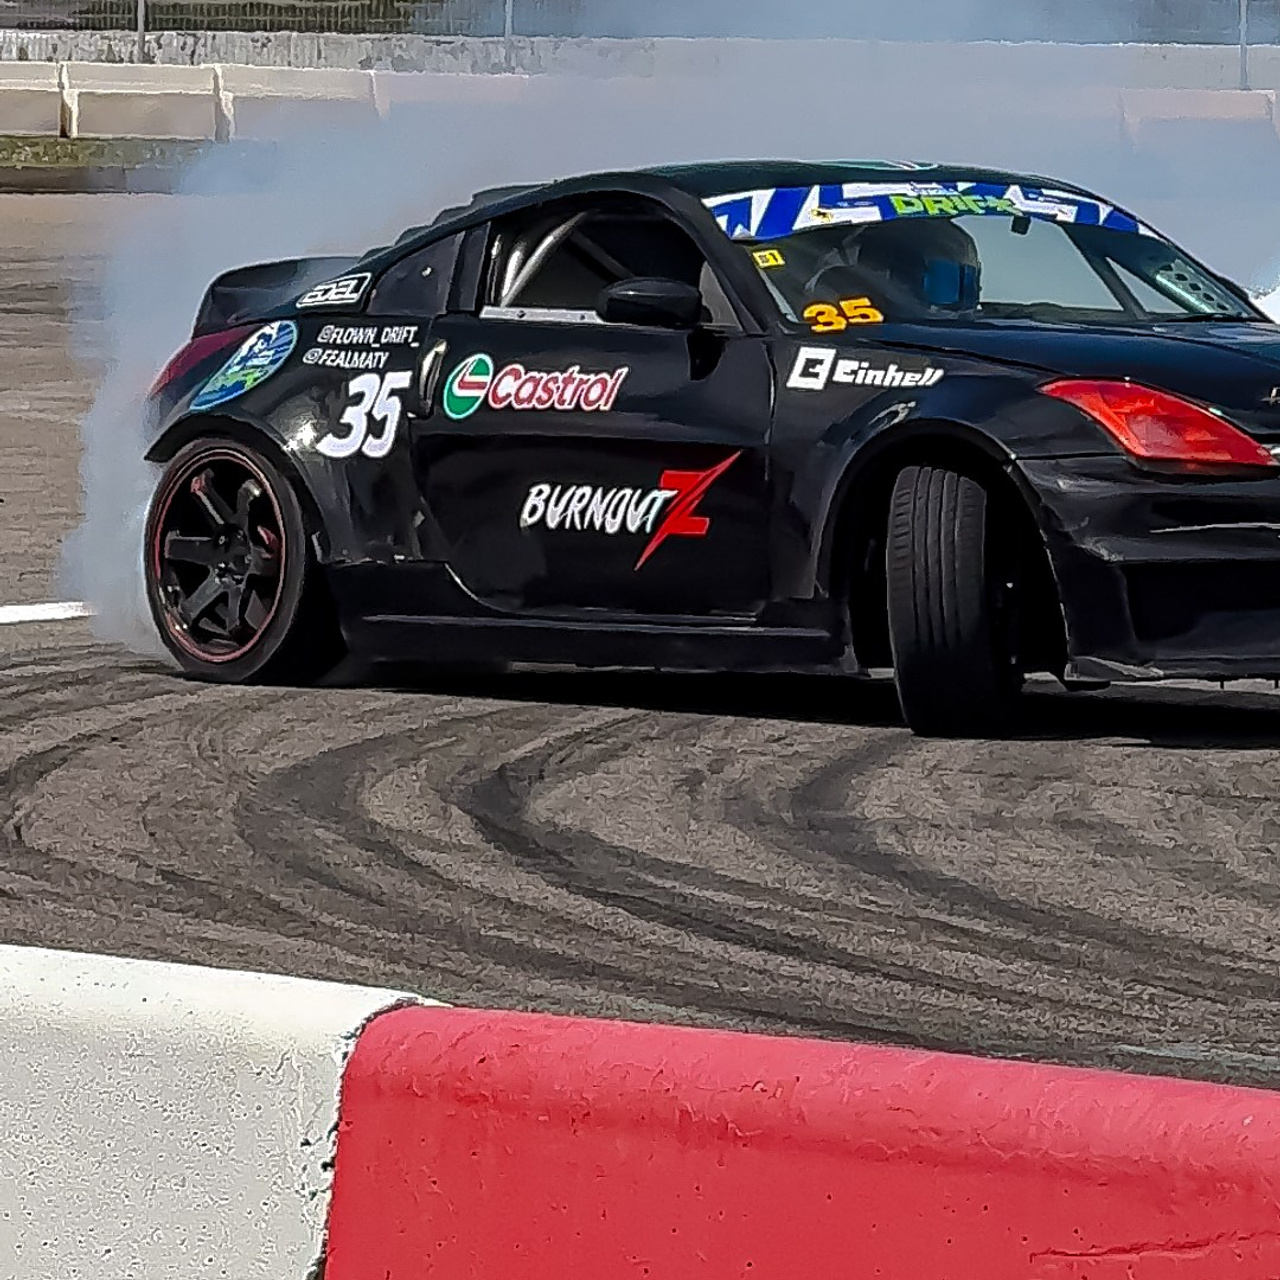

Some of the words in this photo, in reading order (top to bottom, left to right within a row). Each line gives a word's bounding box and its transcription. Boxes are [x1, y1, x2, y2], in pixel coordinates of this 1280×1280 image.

[803, 296, 885, 333] 35
[302, 348, 390, 370] @FEALMATY
[832, 358, 945, 388] Einhell
[487, 363, 629, 411] Castrol
[315, 370, 413, 458] 35
[520, 483, 679, 535] BURNOUT
